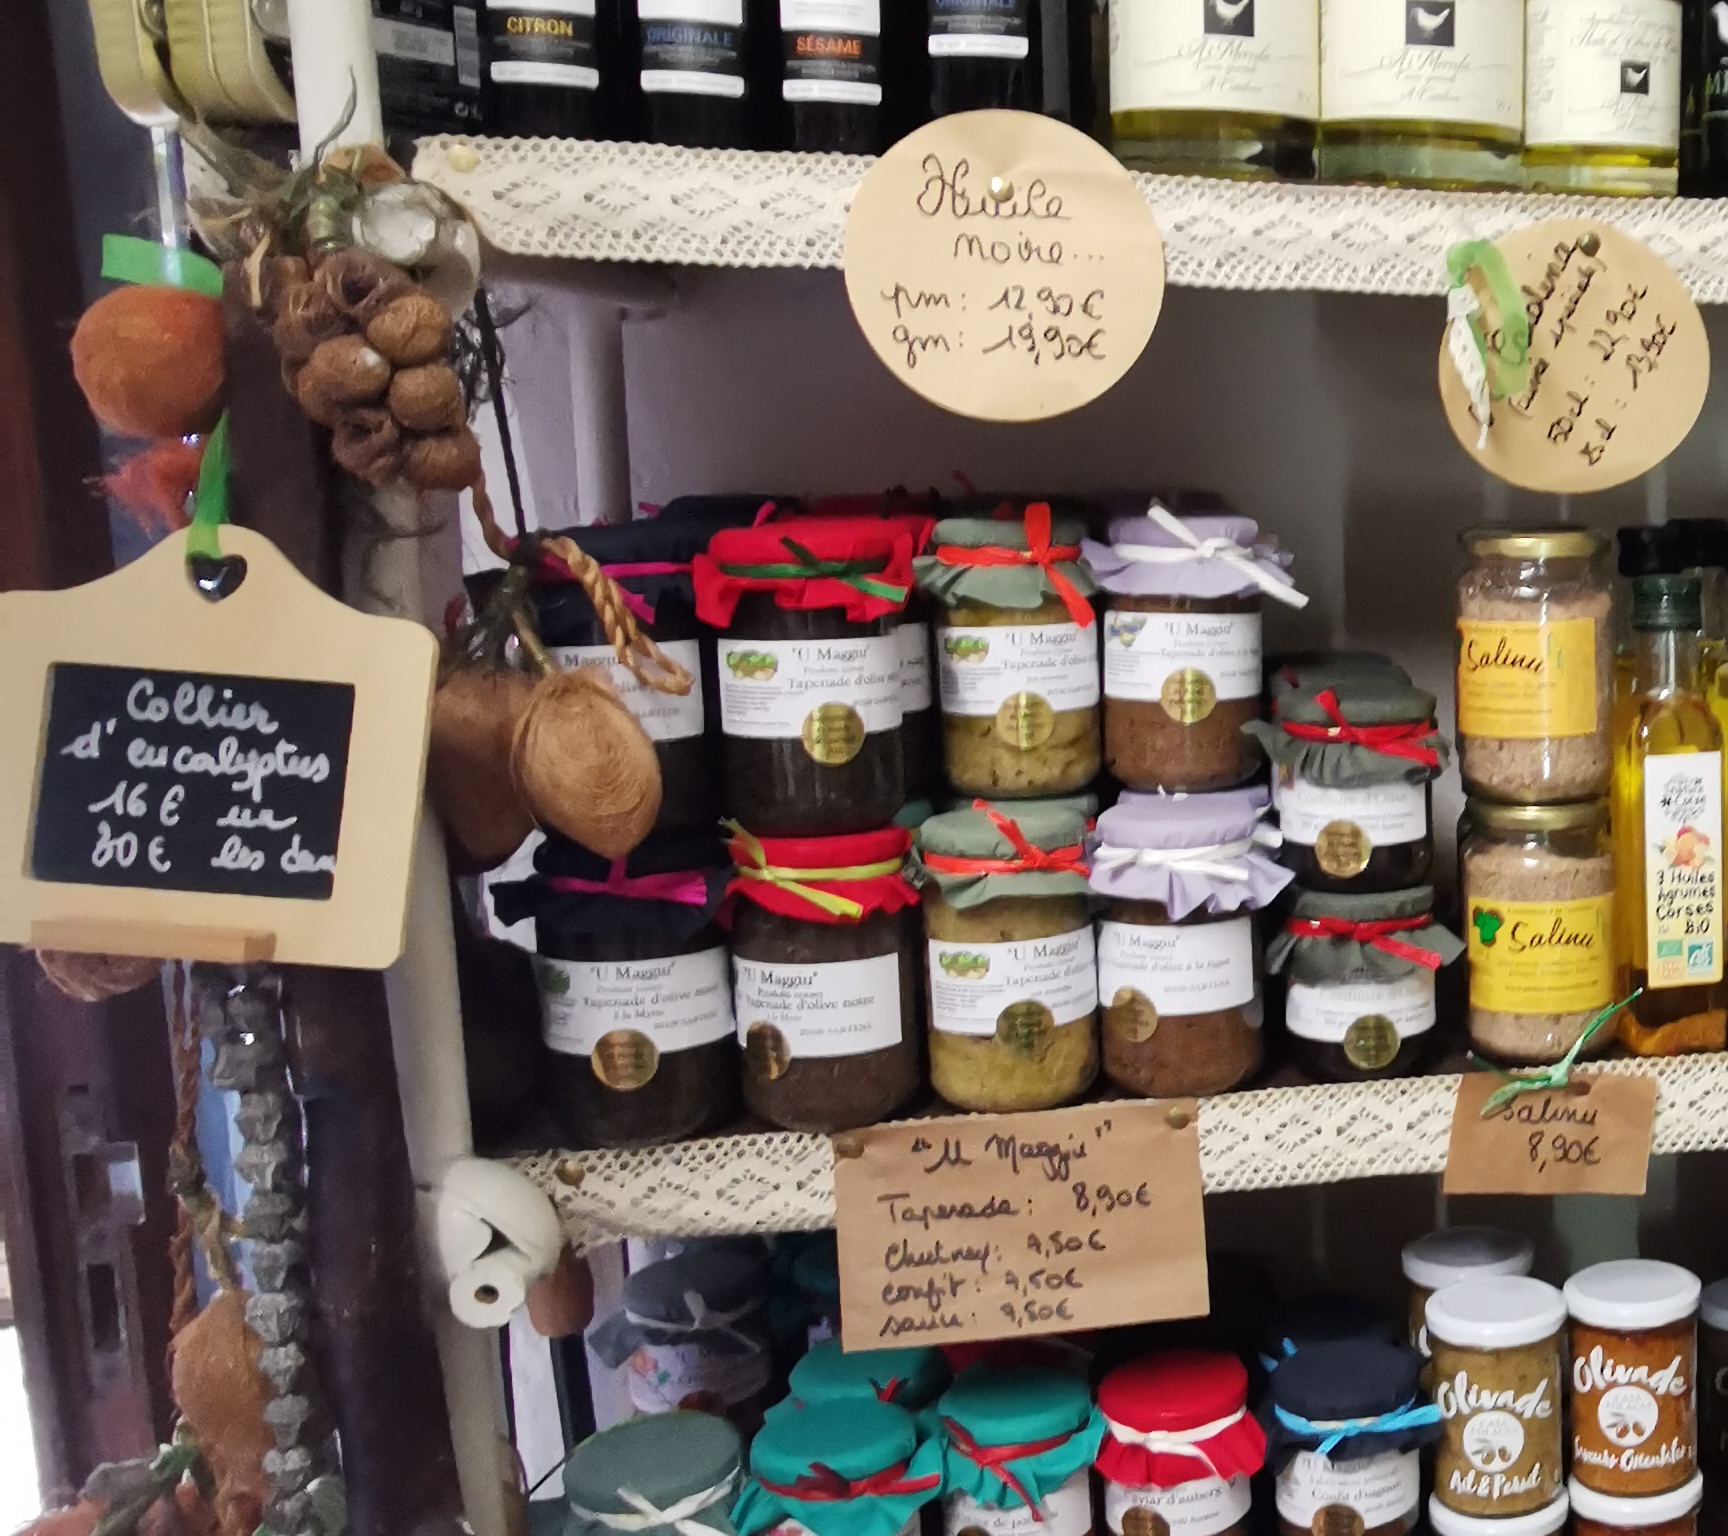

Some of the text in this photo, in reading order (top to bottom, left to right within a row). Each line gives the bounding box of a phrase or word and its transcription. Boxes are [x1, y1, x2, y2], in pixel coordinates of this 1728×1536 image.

[506, 16, 574, 38] CITRON
[646, 28, 733, 49] ORIGINALE
[795, 33, 862, 56] SÉSAME
[915, 152, 1074, 219] Huile
[787, 676, 851, 693] Tapenade
[126, 677, 279, 735] Collier
[1656, 868, 1716, 885] 3 Huiles
[1655, 902, 1714, 921] Corses
[1527, 1129, 1602, 1174] 8,90€
[1071, 1180, 1153, 1218] 8,90€
[1572, 1344, 1688, 1397] Olivade
[1436, 1369, 1554, 1420] Olivade
